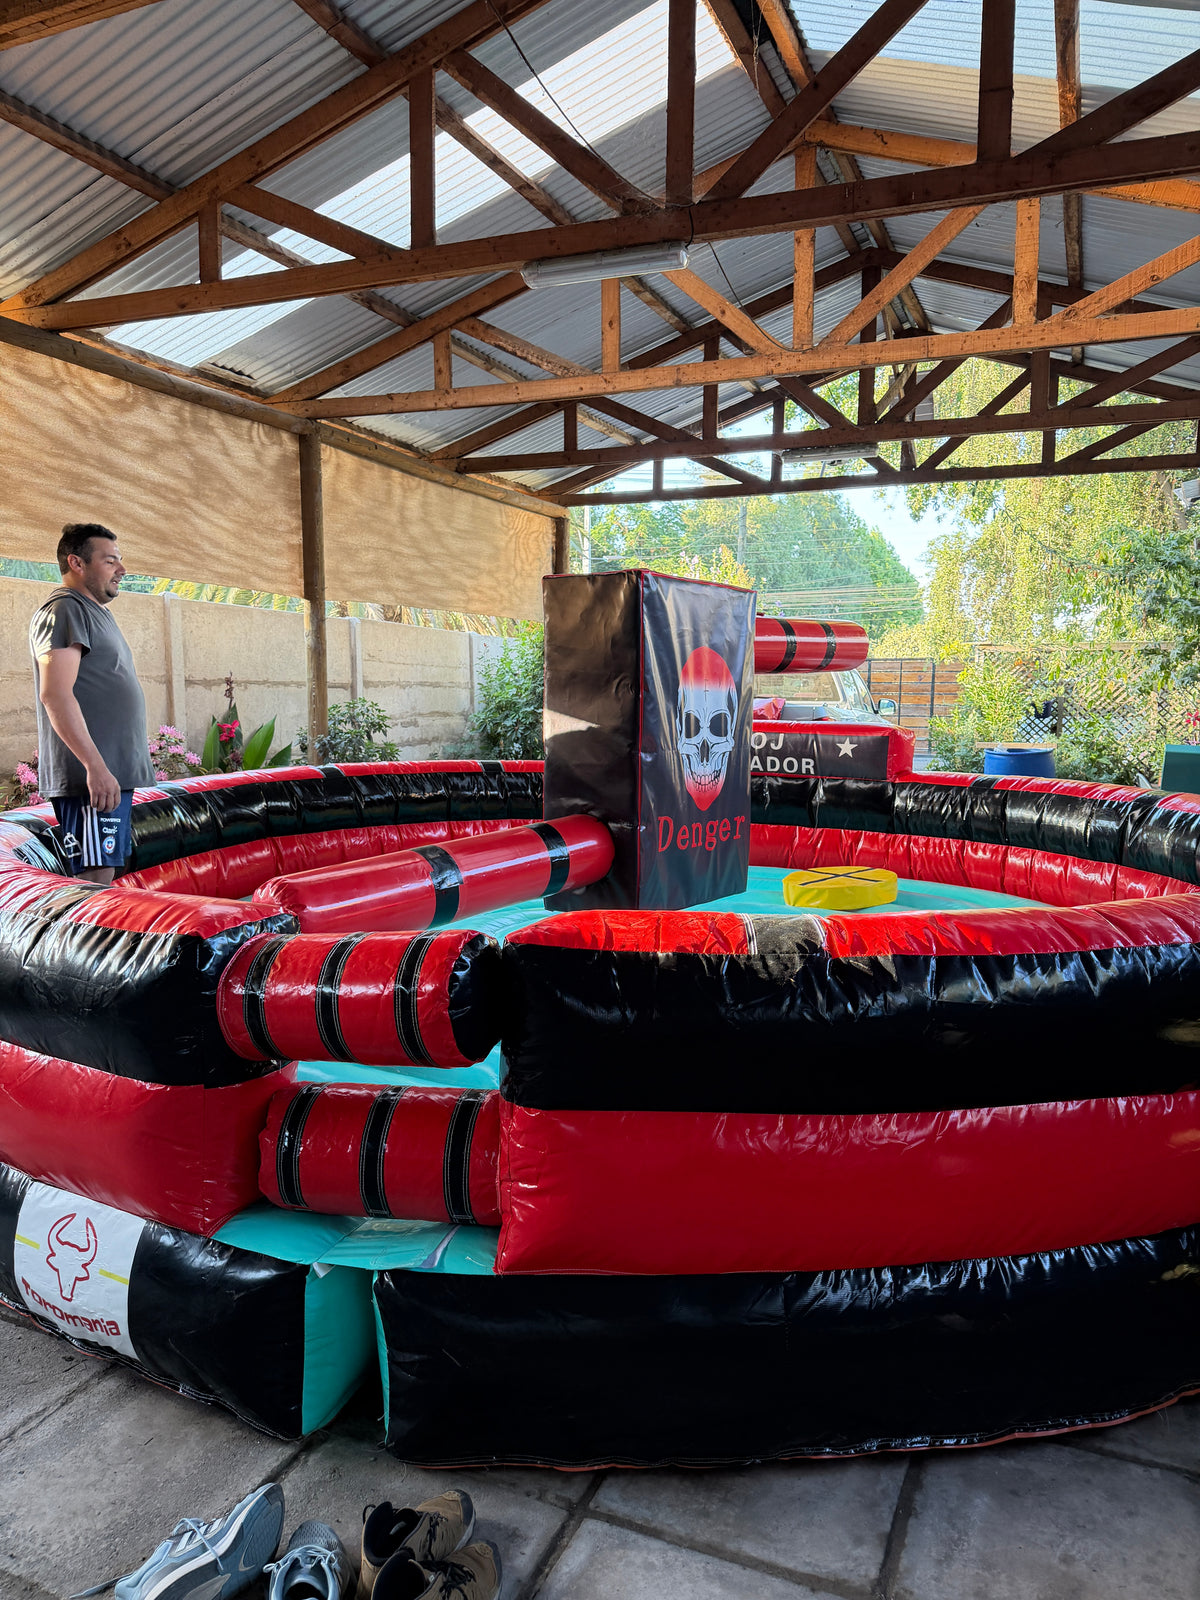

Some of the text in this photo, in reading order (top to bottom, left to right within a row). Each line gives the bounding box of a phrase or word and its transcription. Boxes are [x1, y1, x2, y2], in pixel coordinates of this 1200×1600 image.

[751, 732, 785, 750] OJ
[751, 755, 815, 775] ADOR
[658, 815, 745, 852] Denger
[21, 1276, 121, 1336] Toromania
